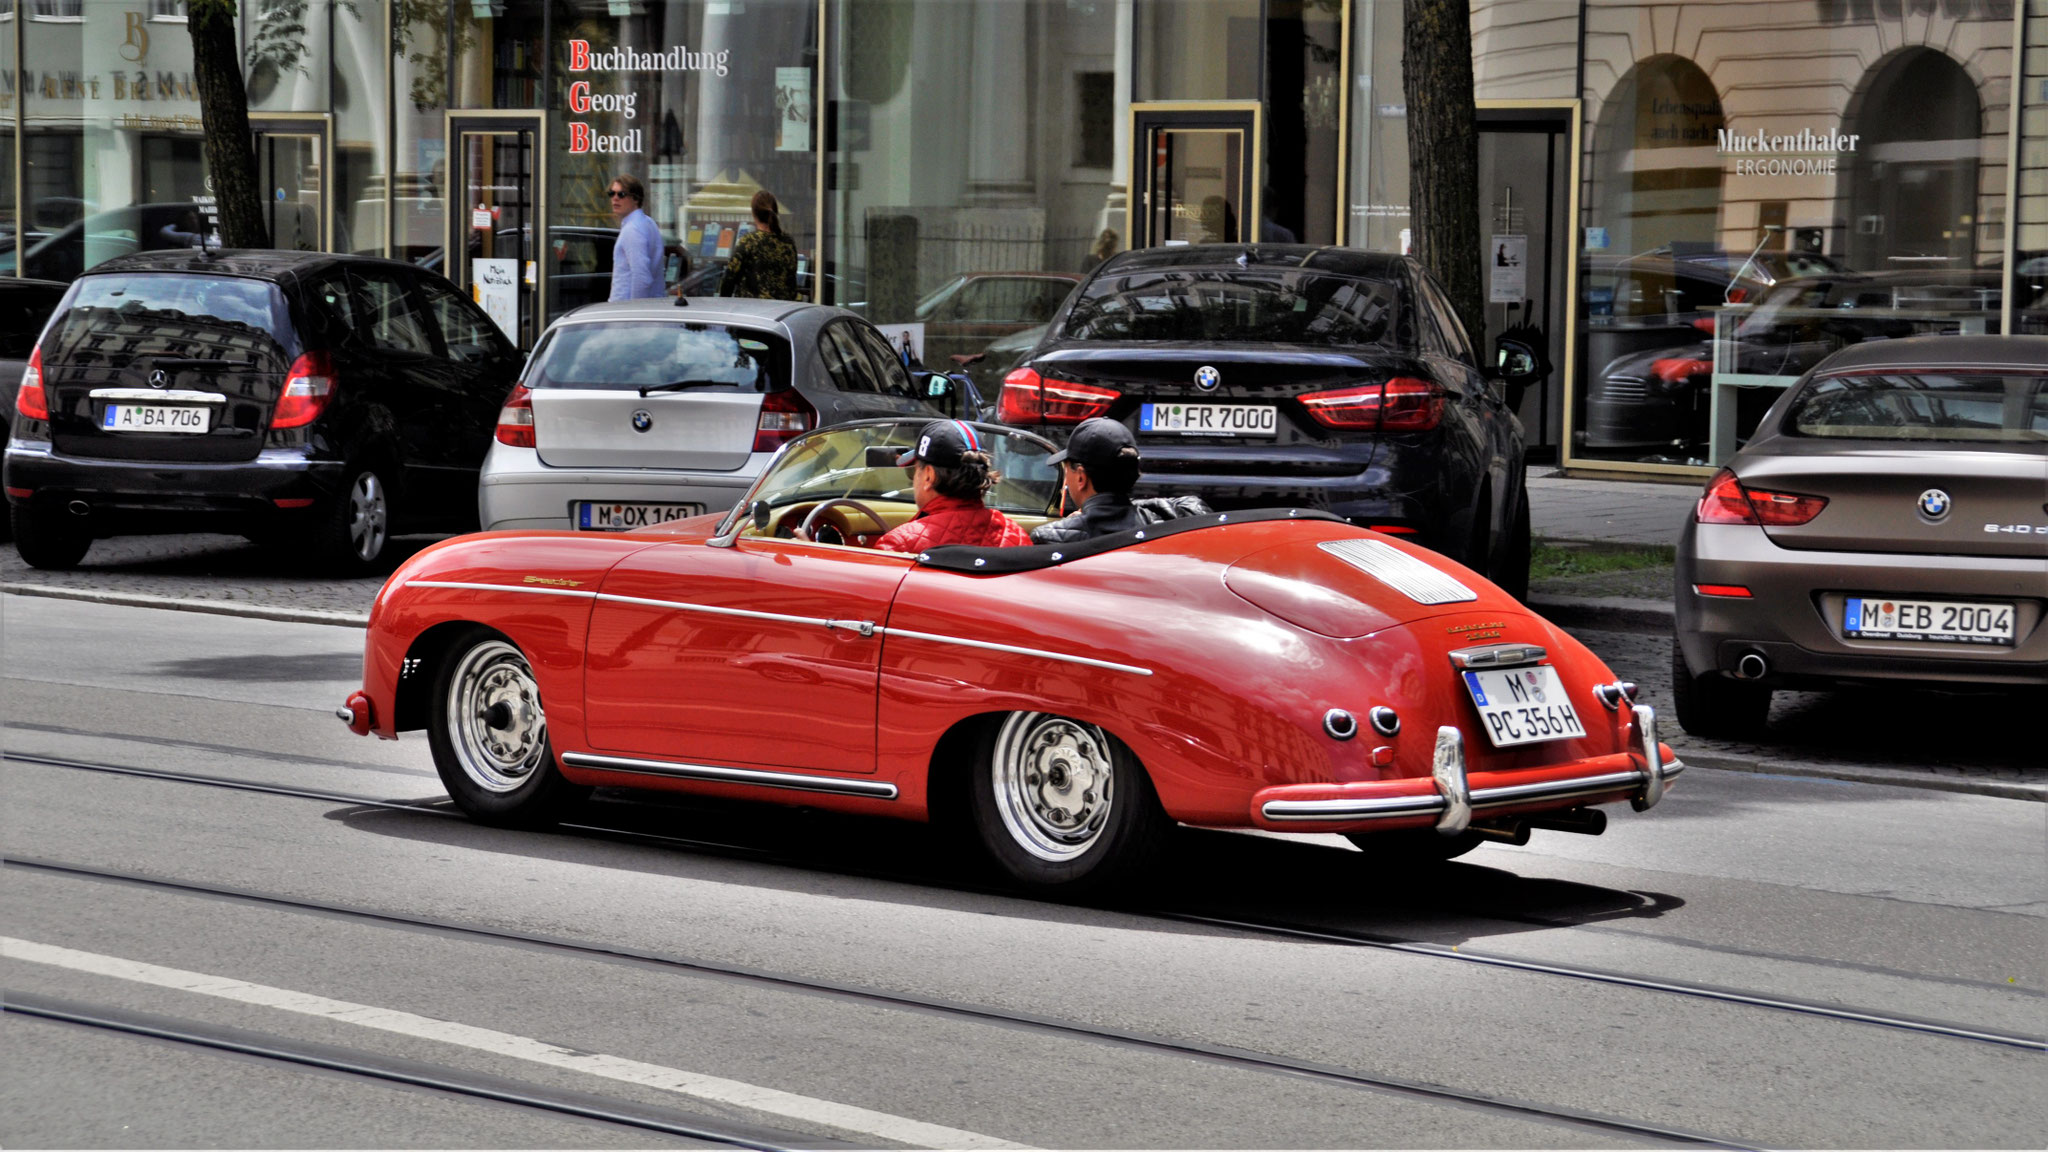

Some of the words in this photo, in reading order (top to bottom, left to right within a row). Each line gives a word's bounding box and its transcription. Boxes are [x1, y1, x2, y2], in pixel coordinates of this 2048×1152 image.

[569, 40, 730, 77] Buchhandlung
[569, 80, 637, 119] Georg
[569, 122, 642, 153] Blendl
[1717, 127, 1860, 153] Muckenthaler
[1736, 159, 1837, 176] ERGONOMIE
[122, 408, 132, 425] A
[144, 409, 165, 425] BA
[171, 410, 201, 426] 706
[1155, 406, 1169, 427] M
[1185, 407, 1213, 428] FR
[1220, 408, 1273, 429] 7000
[919, 435, 931, 457] 8
[599, 506, 611, 524] M
[624, 507, 648, 526] OX
[1862, 603, 1879, 628] M
[1898, 604, 1932, 630] EB
[1941, 606, 2009, 633] 2004
[1505, 673, 1530, 703] M
[1486, 710, 1521, 741] PC
[1517, 706, 1563, 736] 356
[1558, 704, 1581, 733] H
